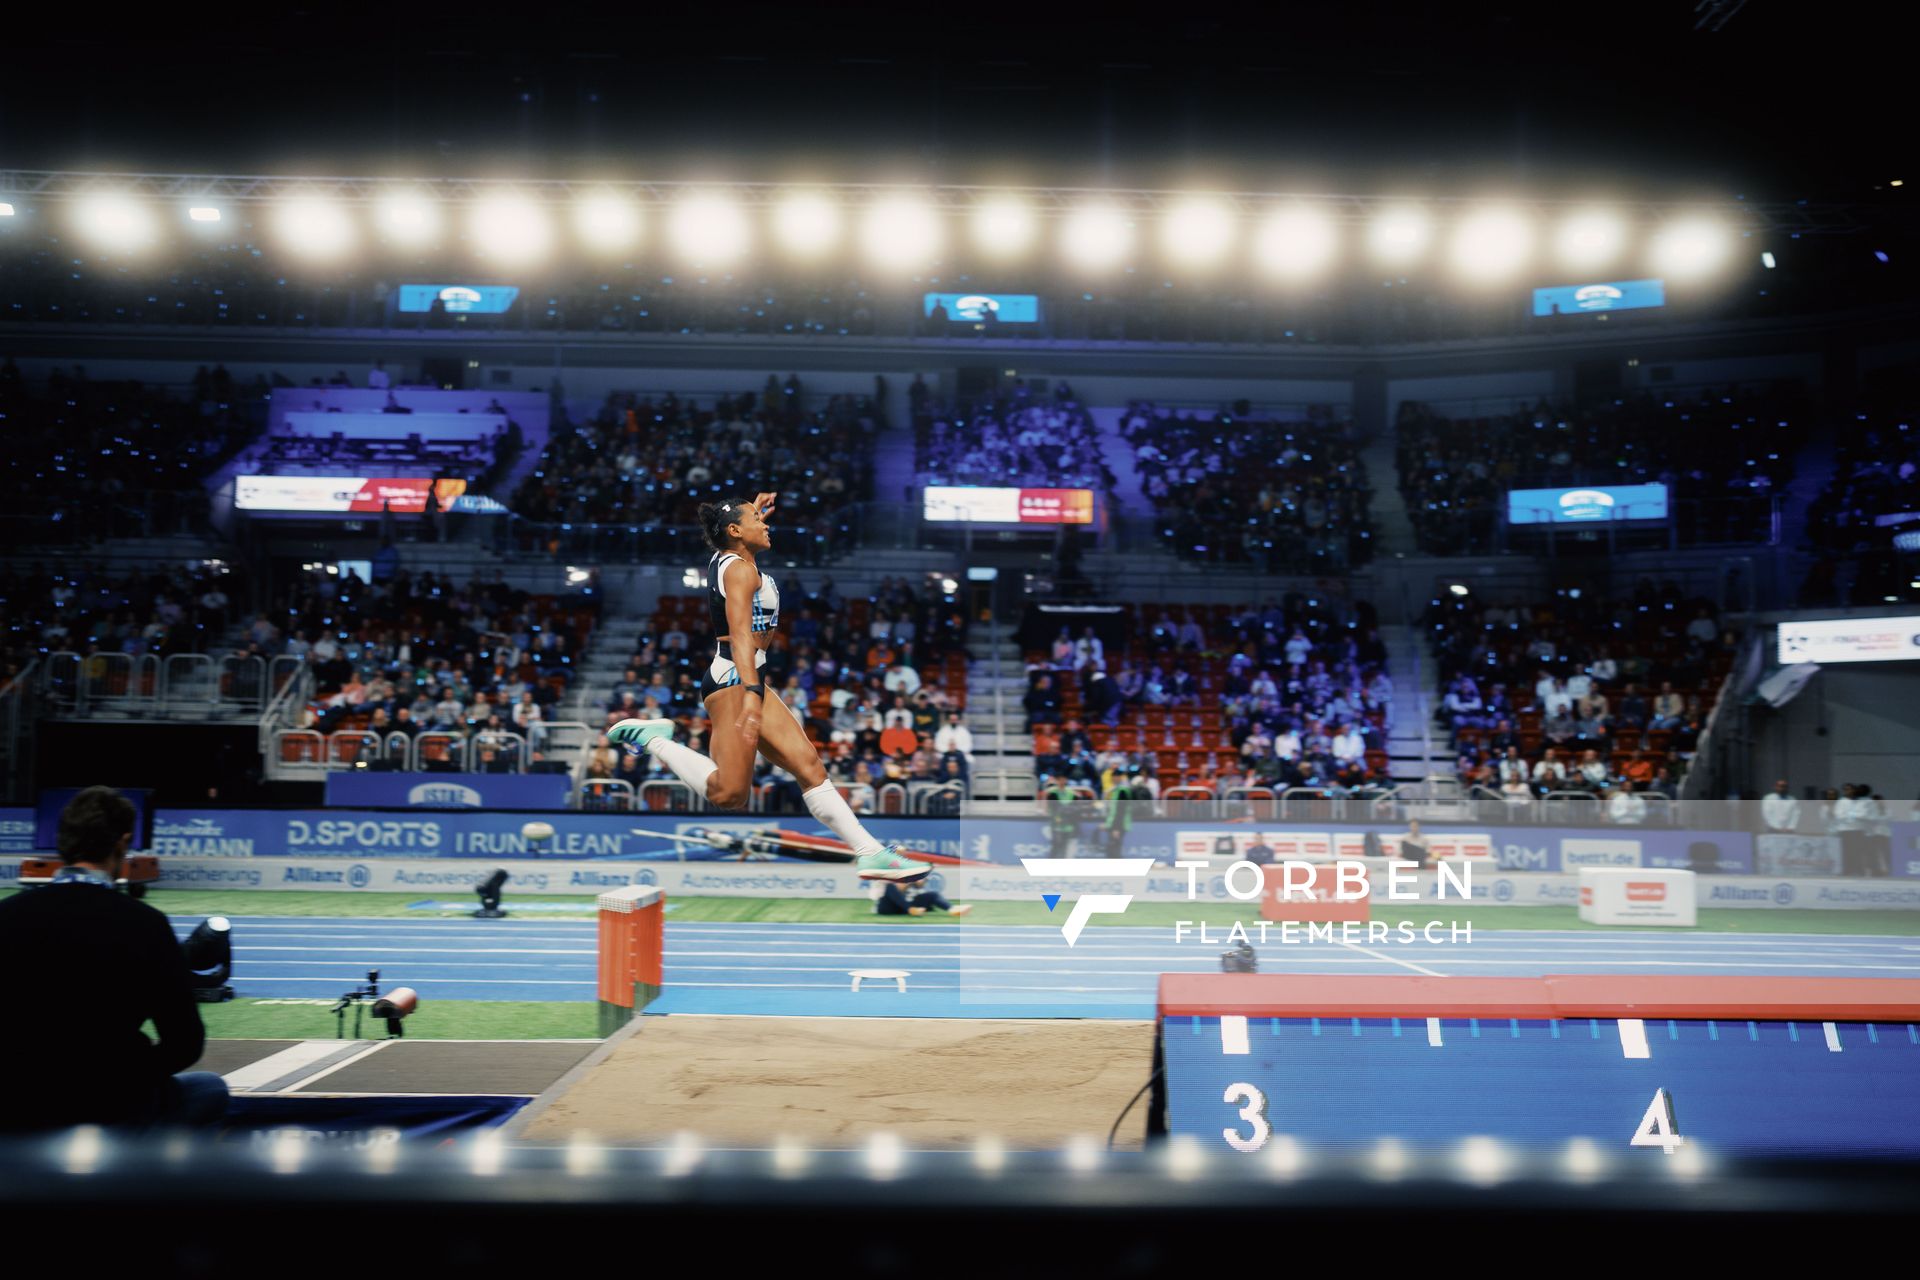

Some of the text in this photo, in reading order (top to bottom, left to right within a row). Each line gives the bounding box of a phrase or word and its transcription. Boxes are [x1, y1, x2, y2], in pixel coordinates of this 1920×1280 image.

[287, 820, 441, 847] D.SPORTS
[469, 833, 527, 854] RUN
[283, 867, 344, 882] Allianz
[570, 870, 631, 886] Allianz
[681, 873, 837, 893] Autoversicherung
[1710, 886, 1769, 901] Allianz
[1223, 1082, 1270, 1153] 3
[1630, 1086, 1682, 1155] 4
